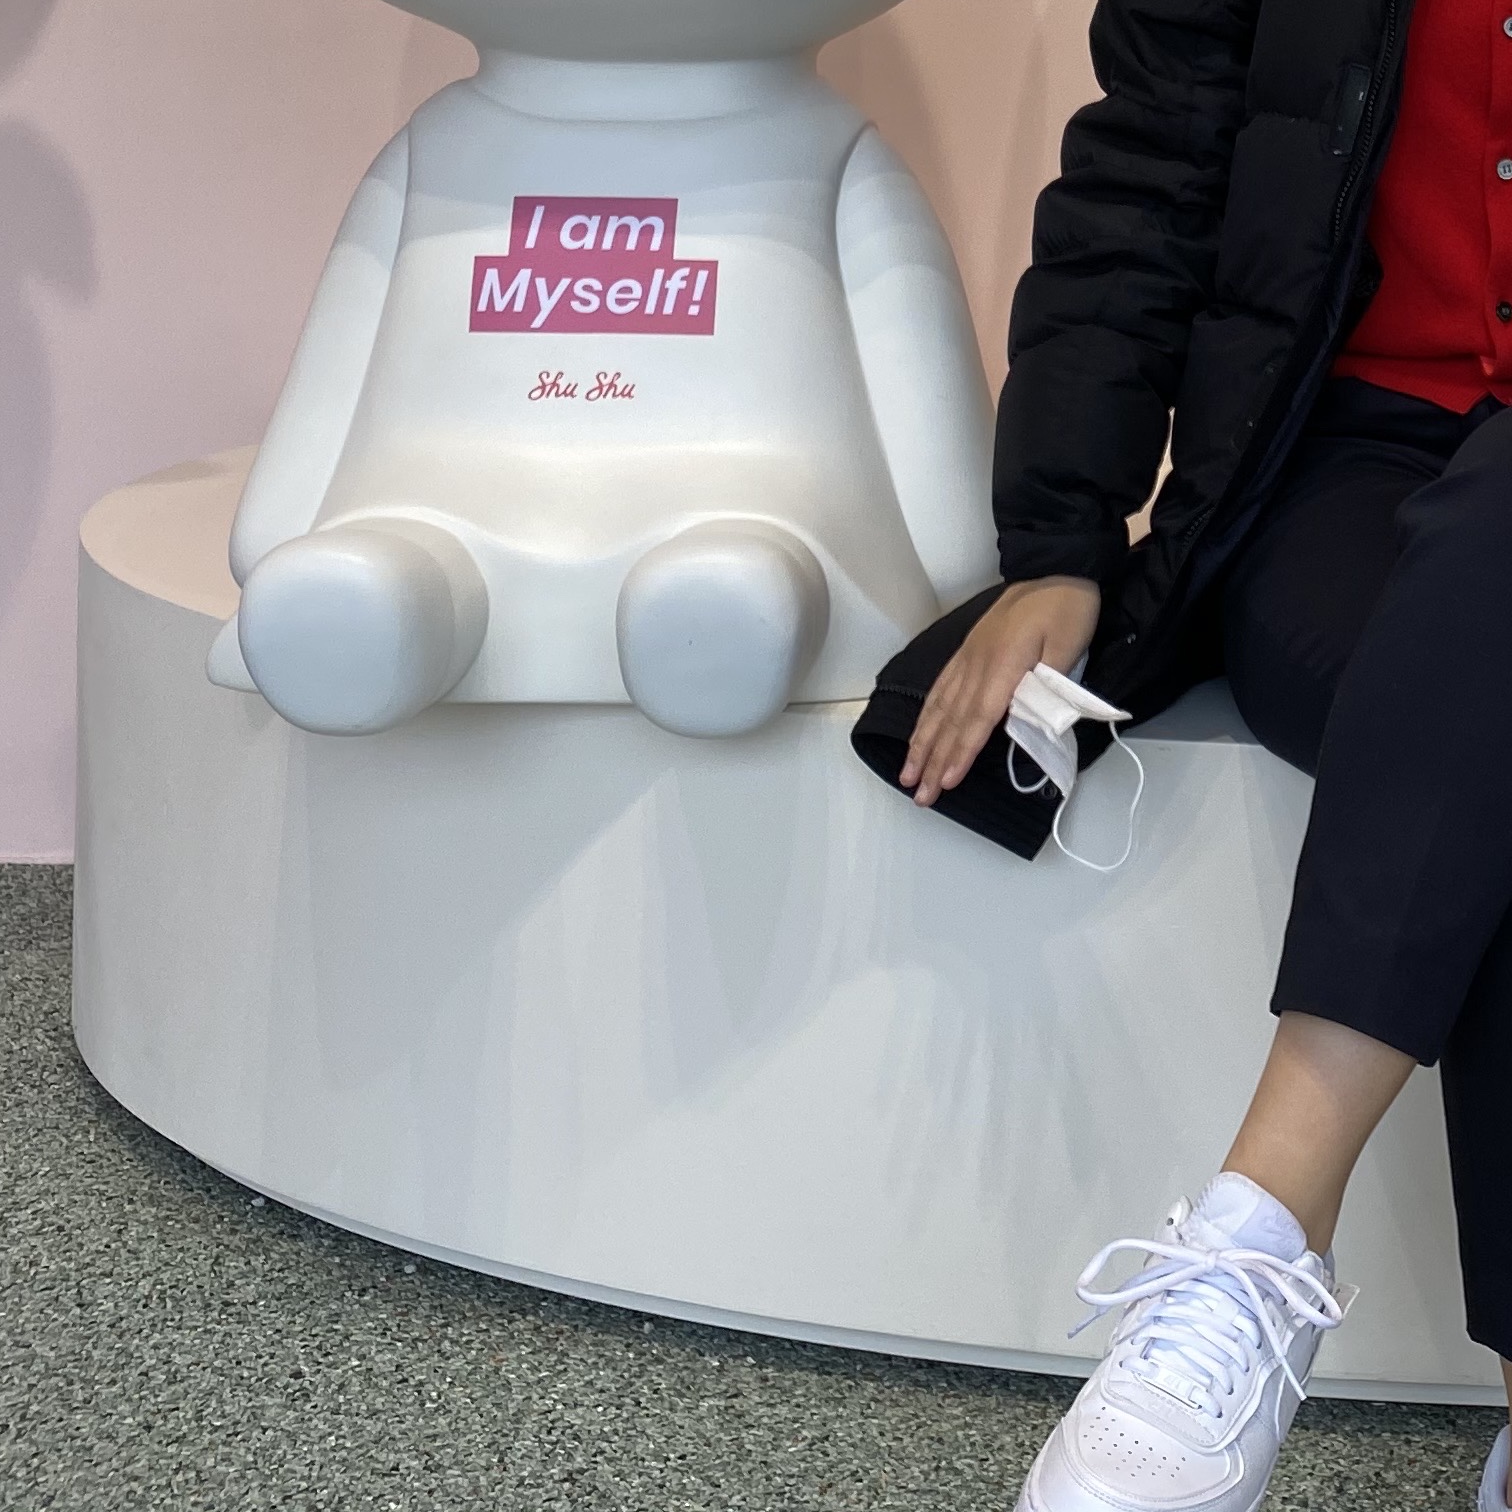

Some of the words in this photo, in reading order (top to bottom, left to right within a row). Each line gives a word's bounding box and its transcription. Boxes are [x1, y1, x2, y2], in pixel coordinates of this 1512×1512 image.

[524, 205, 545, 249] I
[559, 214, 665, 251] am
[476, 267, 709, 328] Myself!
[527, 371, 578, 401] Shu
[585, 372, 635, 402] Shu
